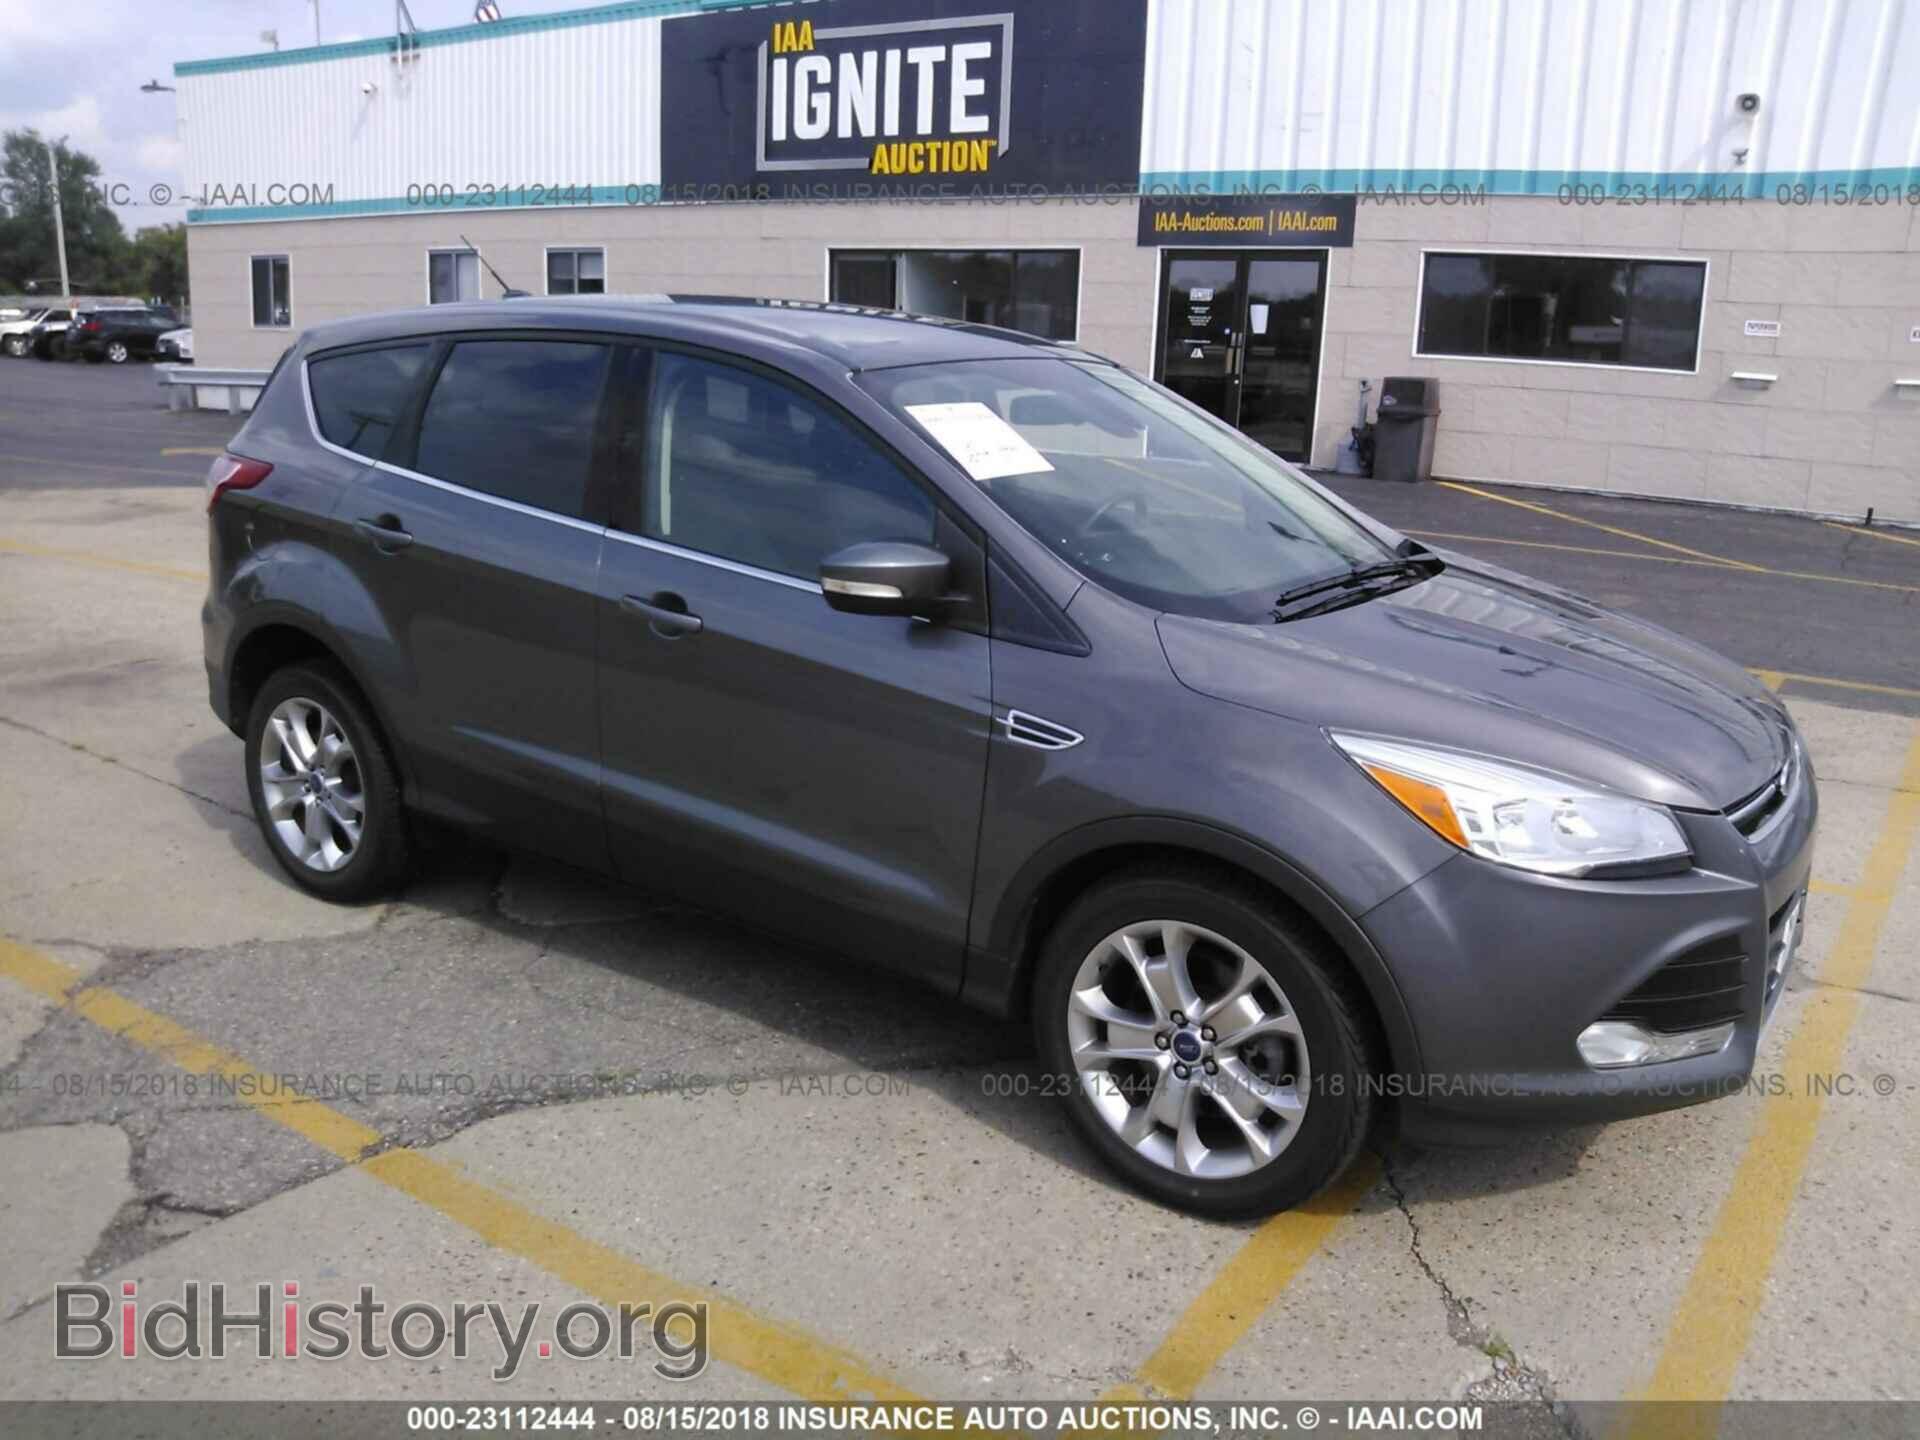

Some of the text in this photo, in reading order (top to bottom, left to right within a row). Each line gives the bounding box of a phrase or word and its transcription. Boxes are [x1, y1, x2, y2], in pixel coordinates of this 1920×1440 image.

[773, 20, 815, 54] IAA
[771, 41, 992, 142] IGNITE
[1154, 210, 1264, 232] IAA-Auctions.com
[1277, 210, 1337, 231] IAAI.com
